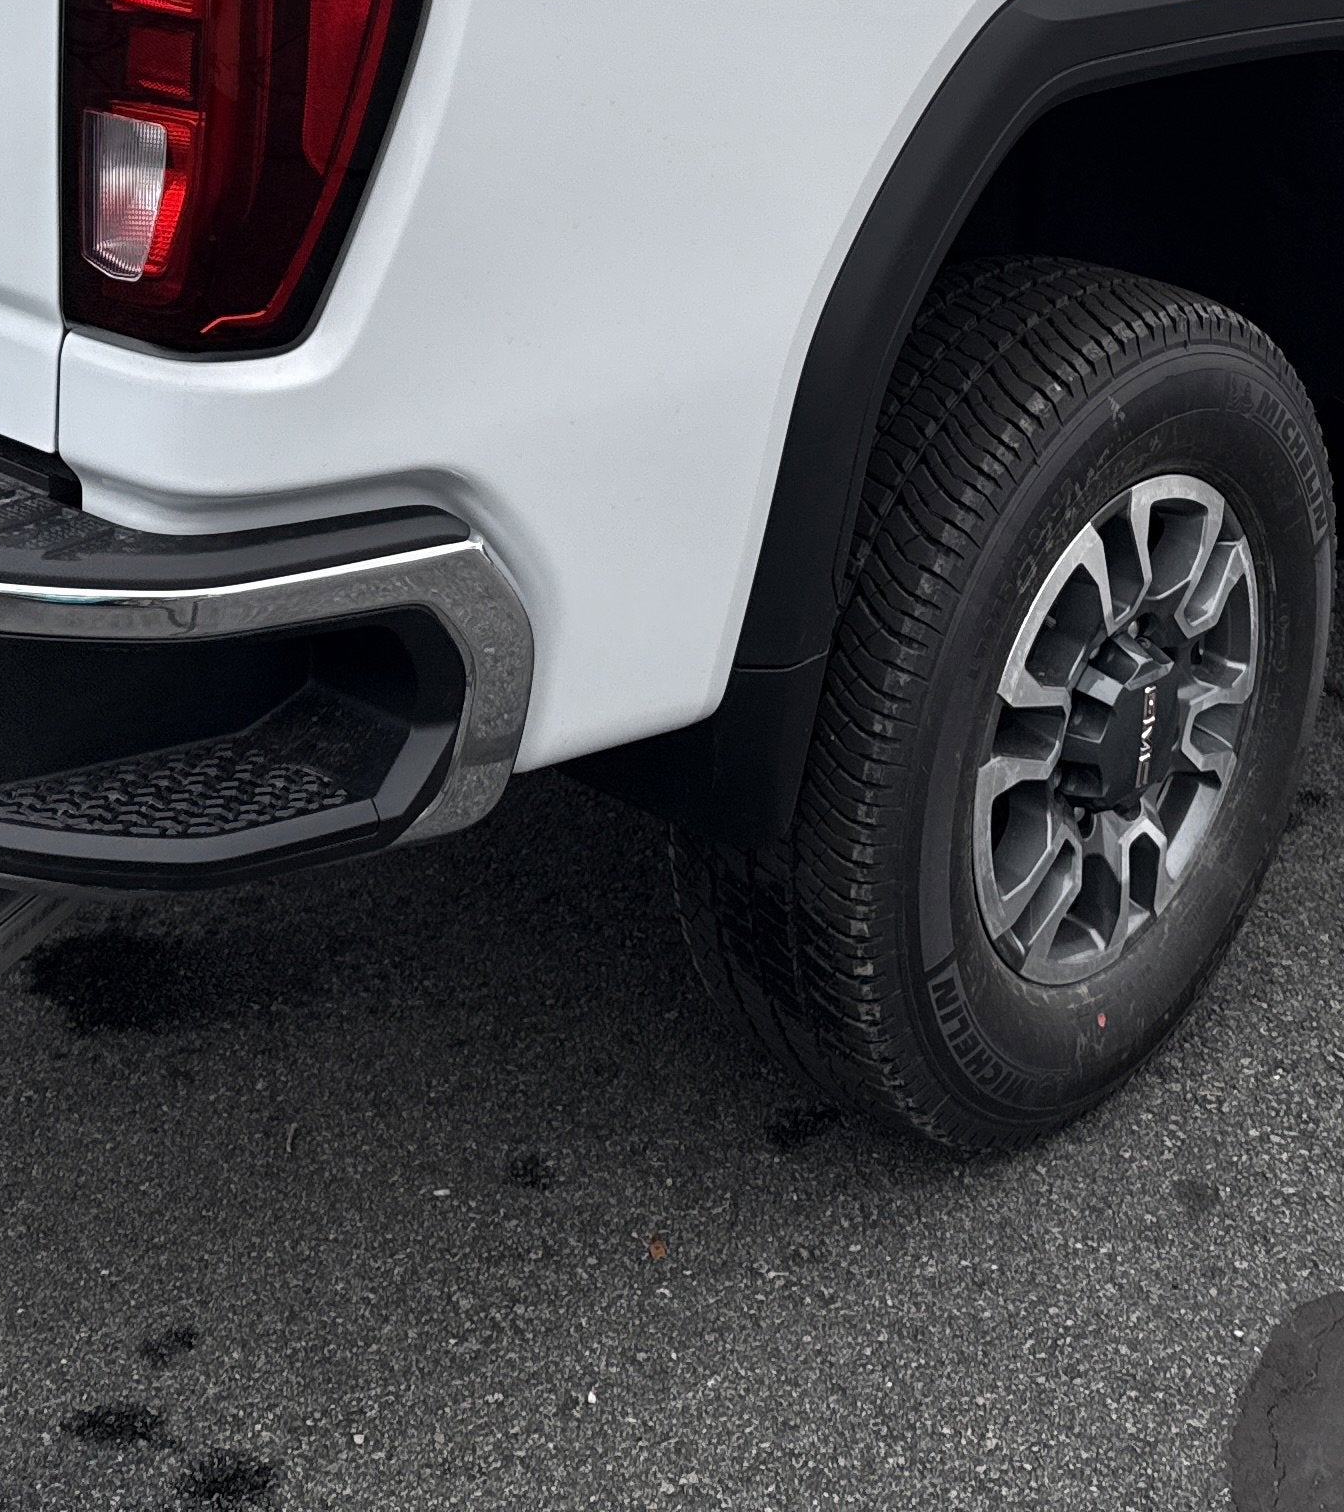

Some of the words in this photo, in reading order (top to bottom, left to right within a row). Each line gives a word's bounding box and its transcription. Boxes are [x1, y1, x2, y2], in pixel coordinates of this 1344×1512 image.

[1256, 388, 1328, 533] MICHELIN
[1135, 686, 1157, 789] GMC
[930, 975, 1033, 1105] MICHELIN
